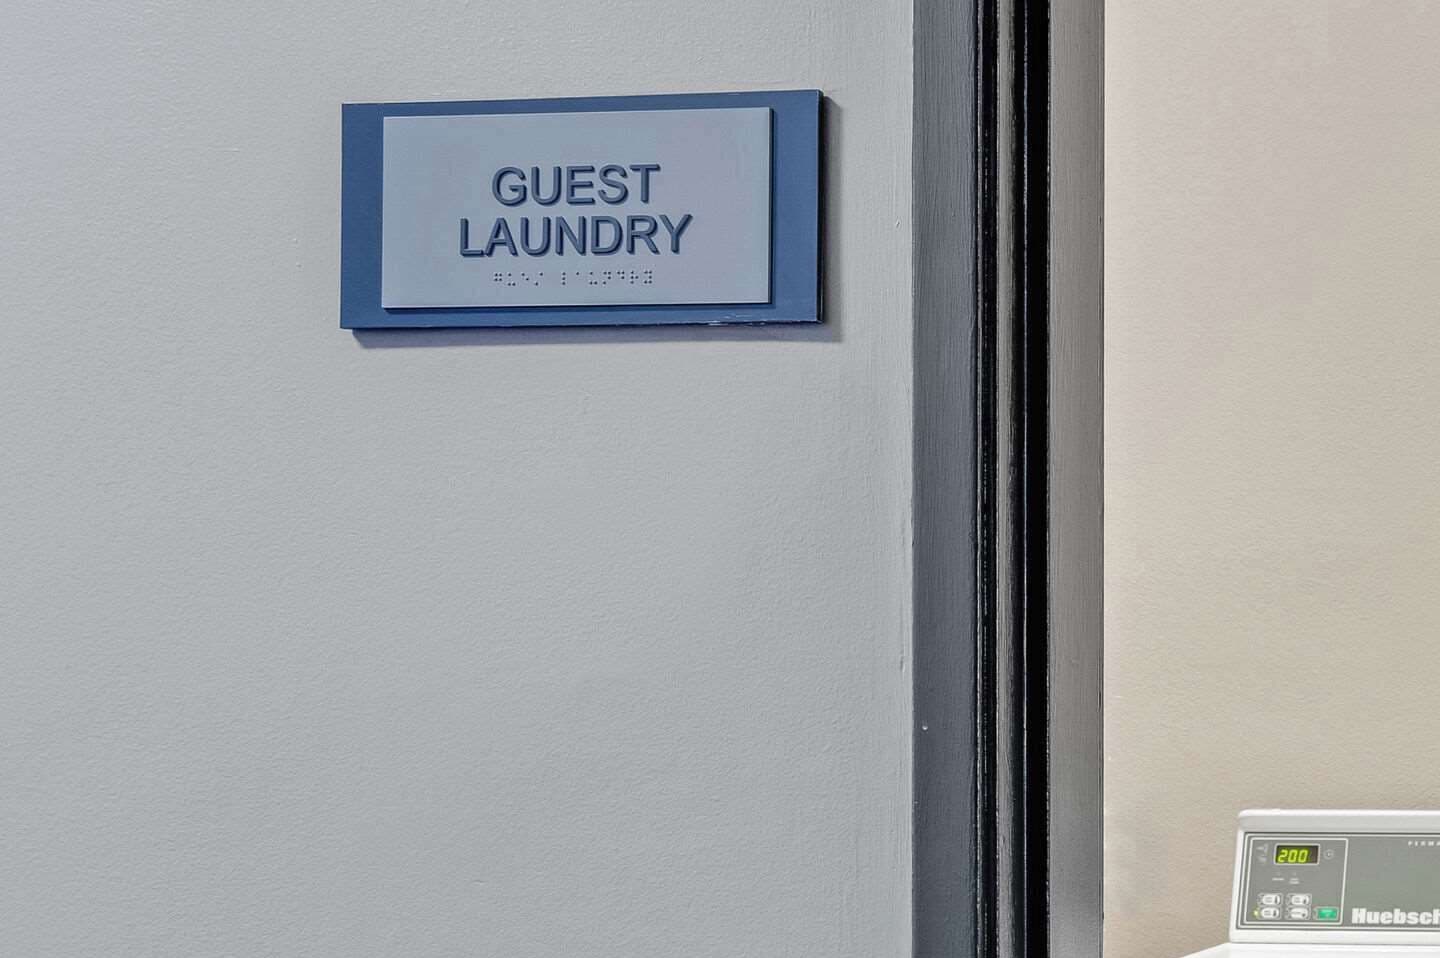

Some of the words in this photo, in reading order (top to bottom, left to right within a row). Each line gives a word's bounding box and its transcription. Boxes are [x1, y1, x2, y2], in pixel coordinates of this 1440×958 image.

[492, 163, 660, 206] GUEST
[459, 213, 693, 257] LAUNDRY
[1277, 849, 1309, 864] 200
